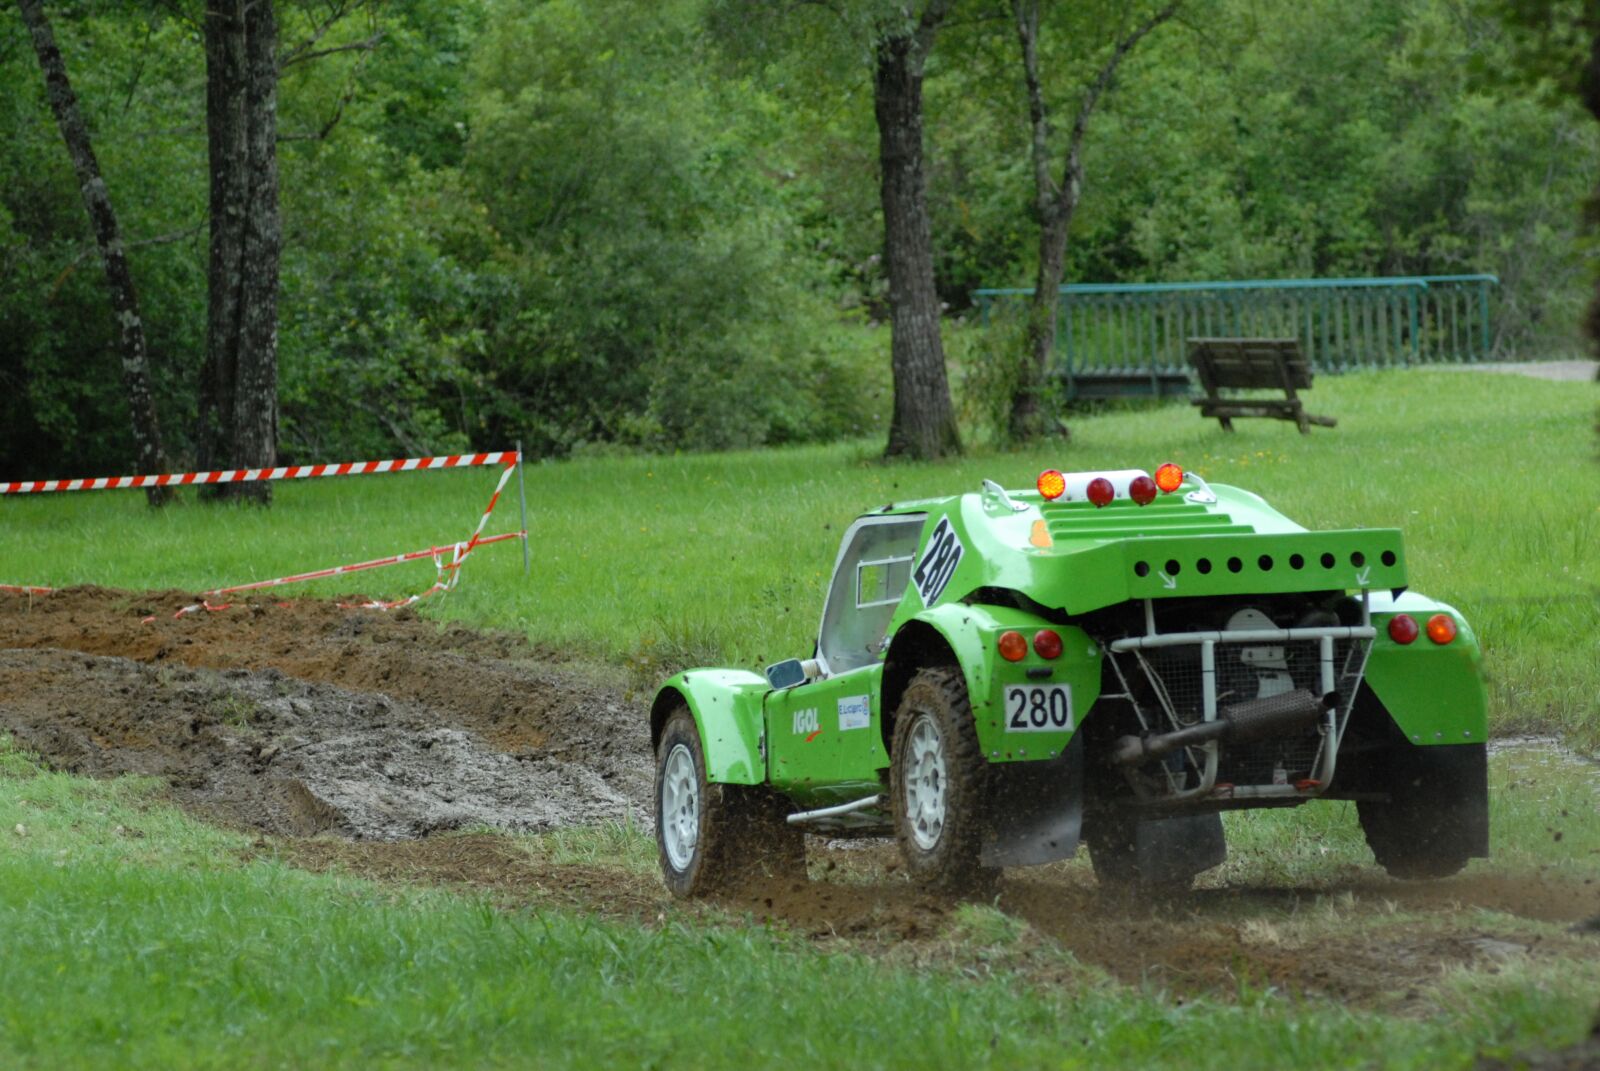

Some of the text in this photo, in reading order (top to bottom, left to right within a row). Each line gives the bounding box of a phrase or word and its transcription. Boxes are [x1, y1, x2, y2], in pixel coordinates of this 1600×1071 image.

[913, 518, 962, 608] 280
[792, 707, 819, 735] IGOL
[1009, 688, 1068, 728] 280
